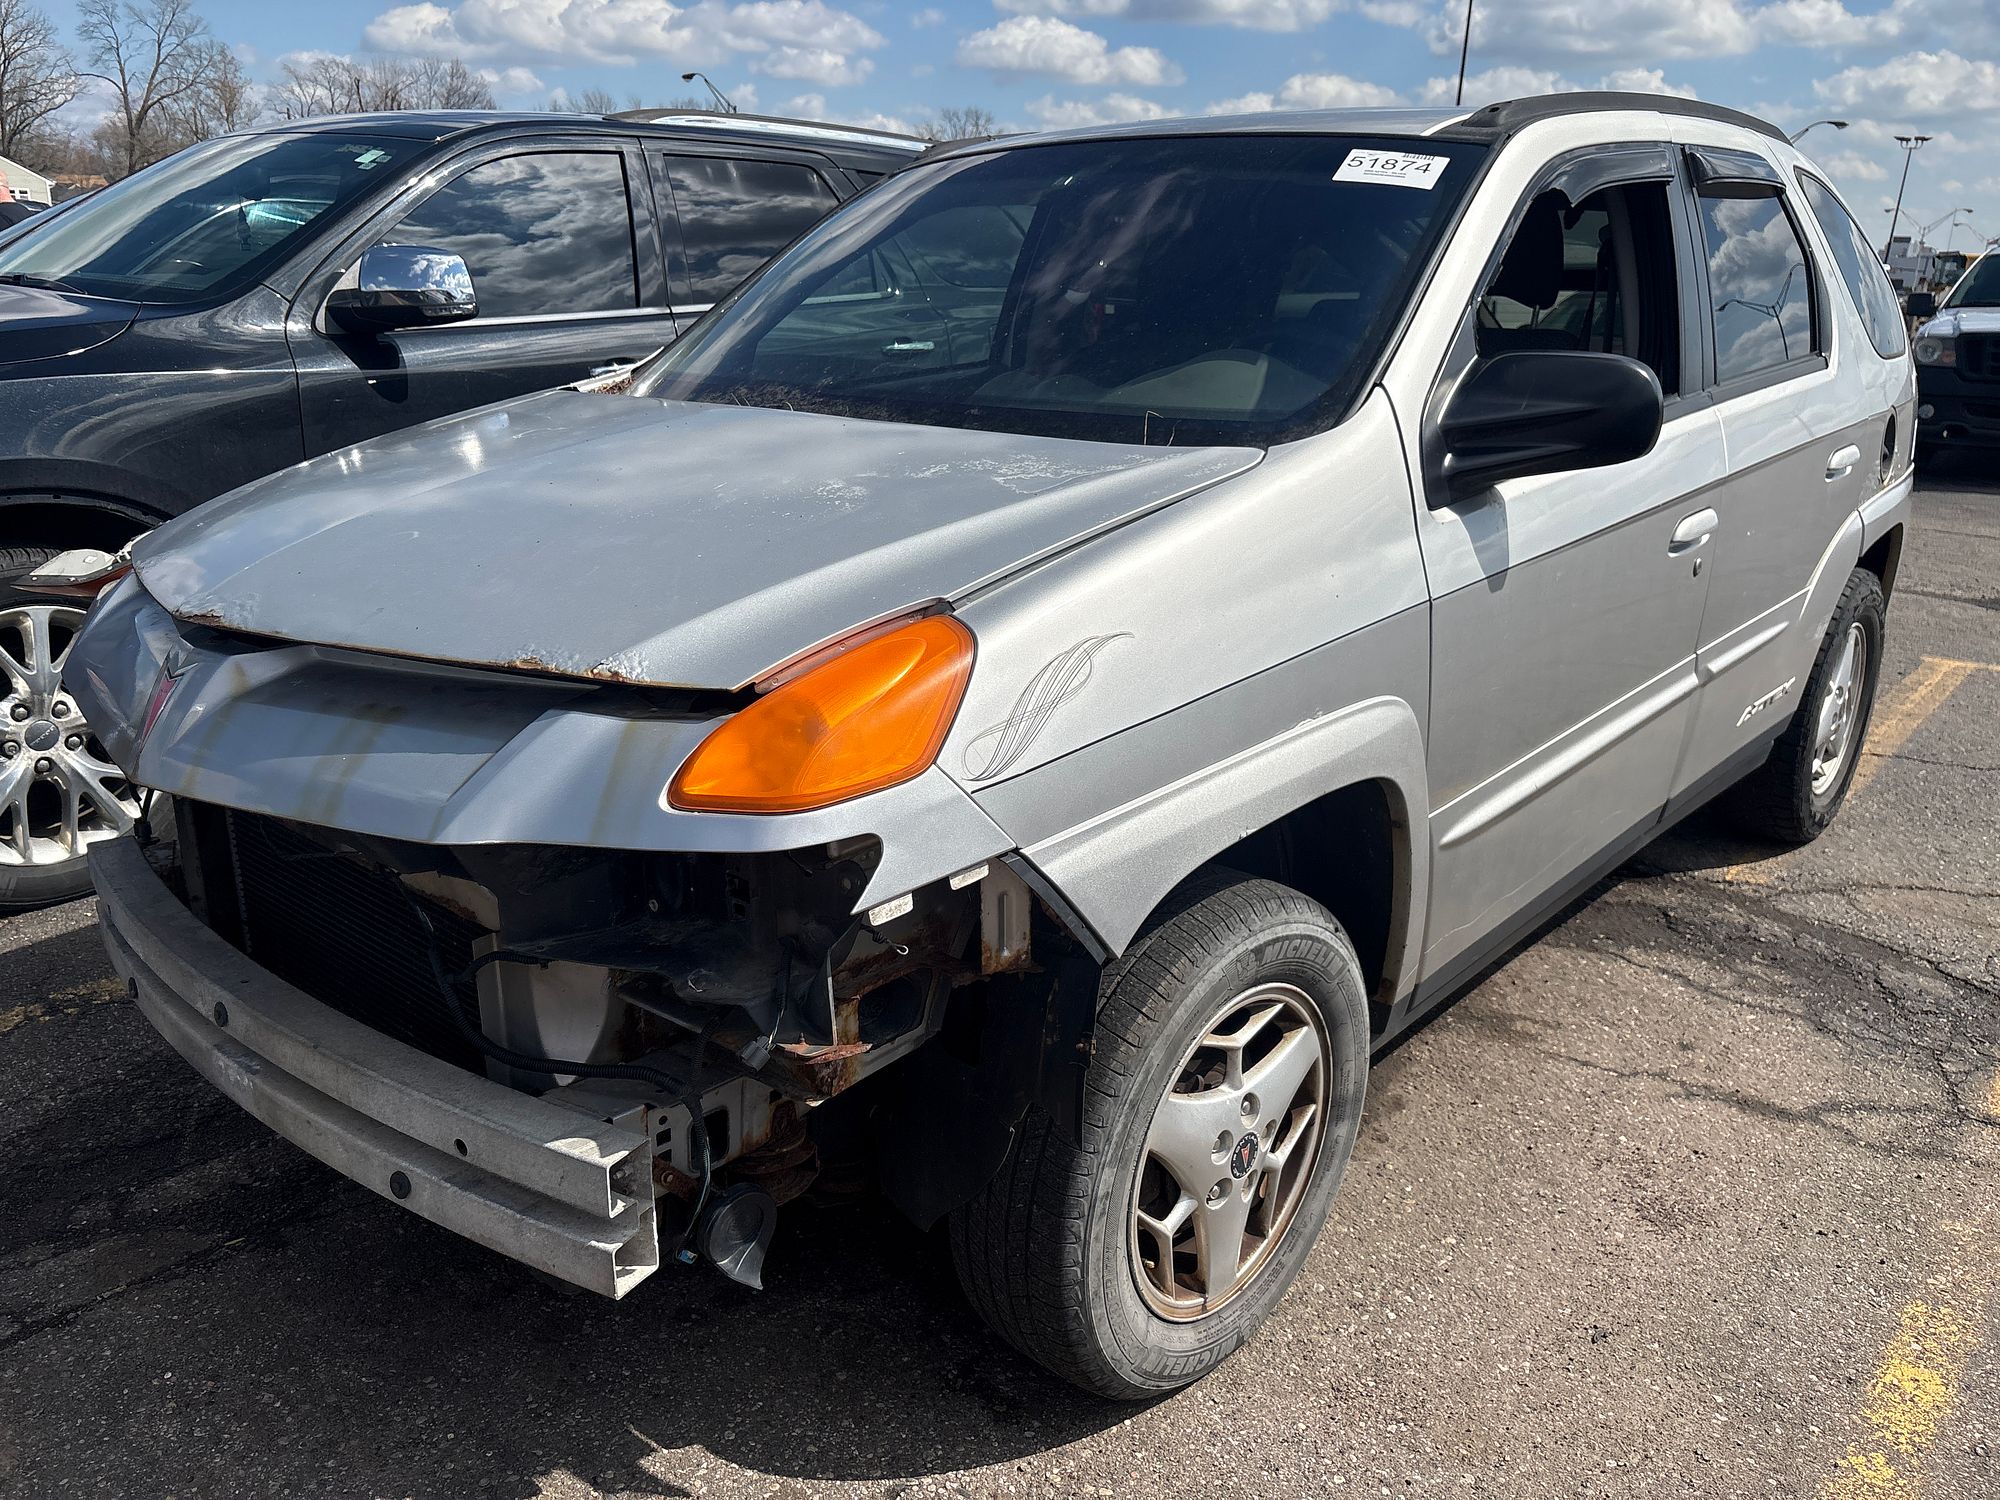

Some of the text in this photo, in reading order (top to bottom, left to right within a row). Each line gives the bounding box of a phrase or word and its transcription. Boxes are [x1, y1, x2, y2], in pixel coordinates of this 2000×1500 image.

[1347, 156, 1431, 173] 51874
[1736, 677, 1796, 726] AZTEK
[1262, 939, 1344, 976] MICHELIN
[1233, 1135, 1258, 1161] PONTIAC
[1142, 1332, 1239, 1376] MICHELIN
